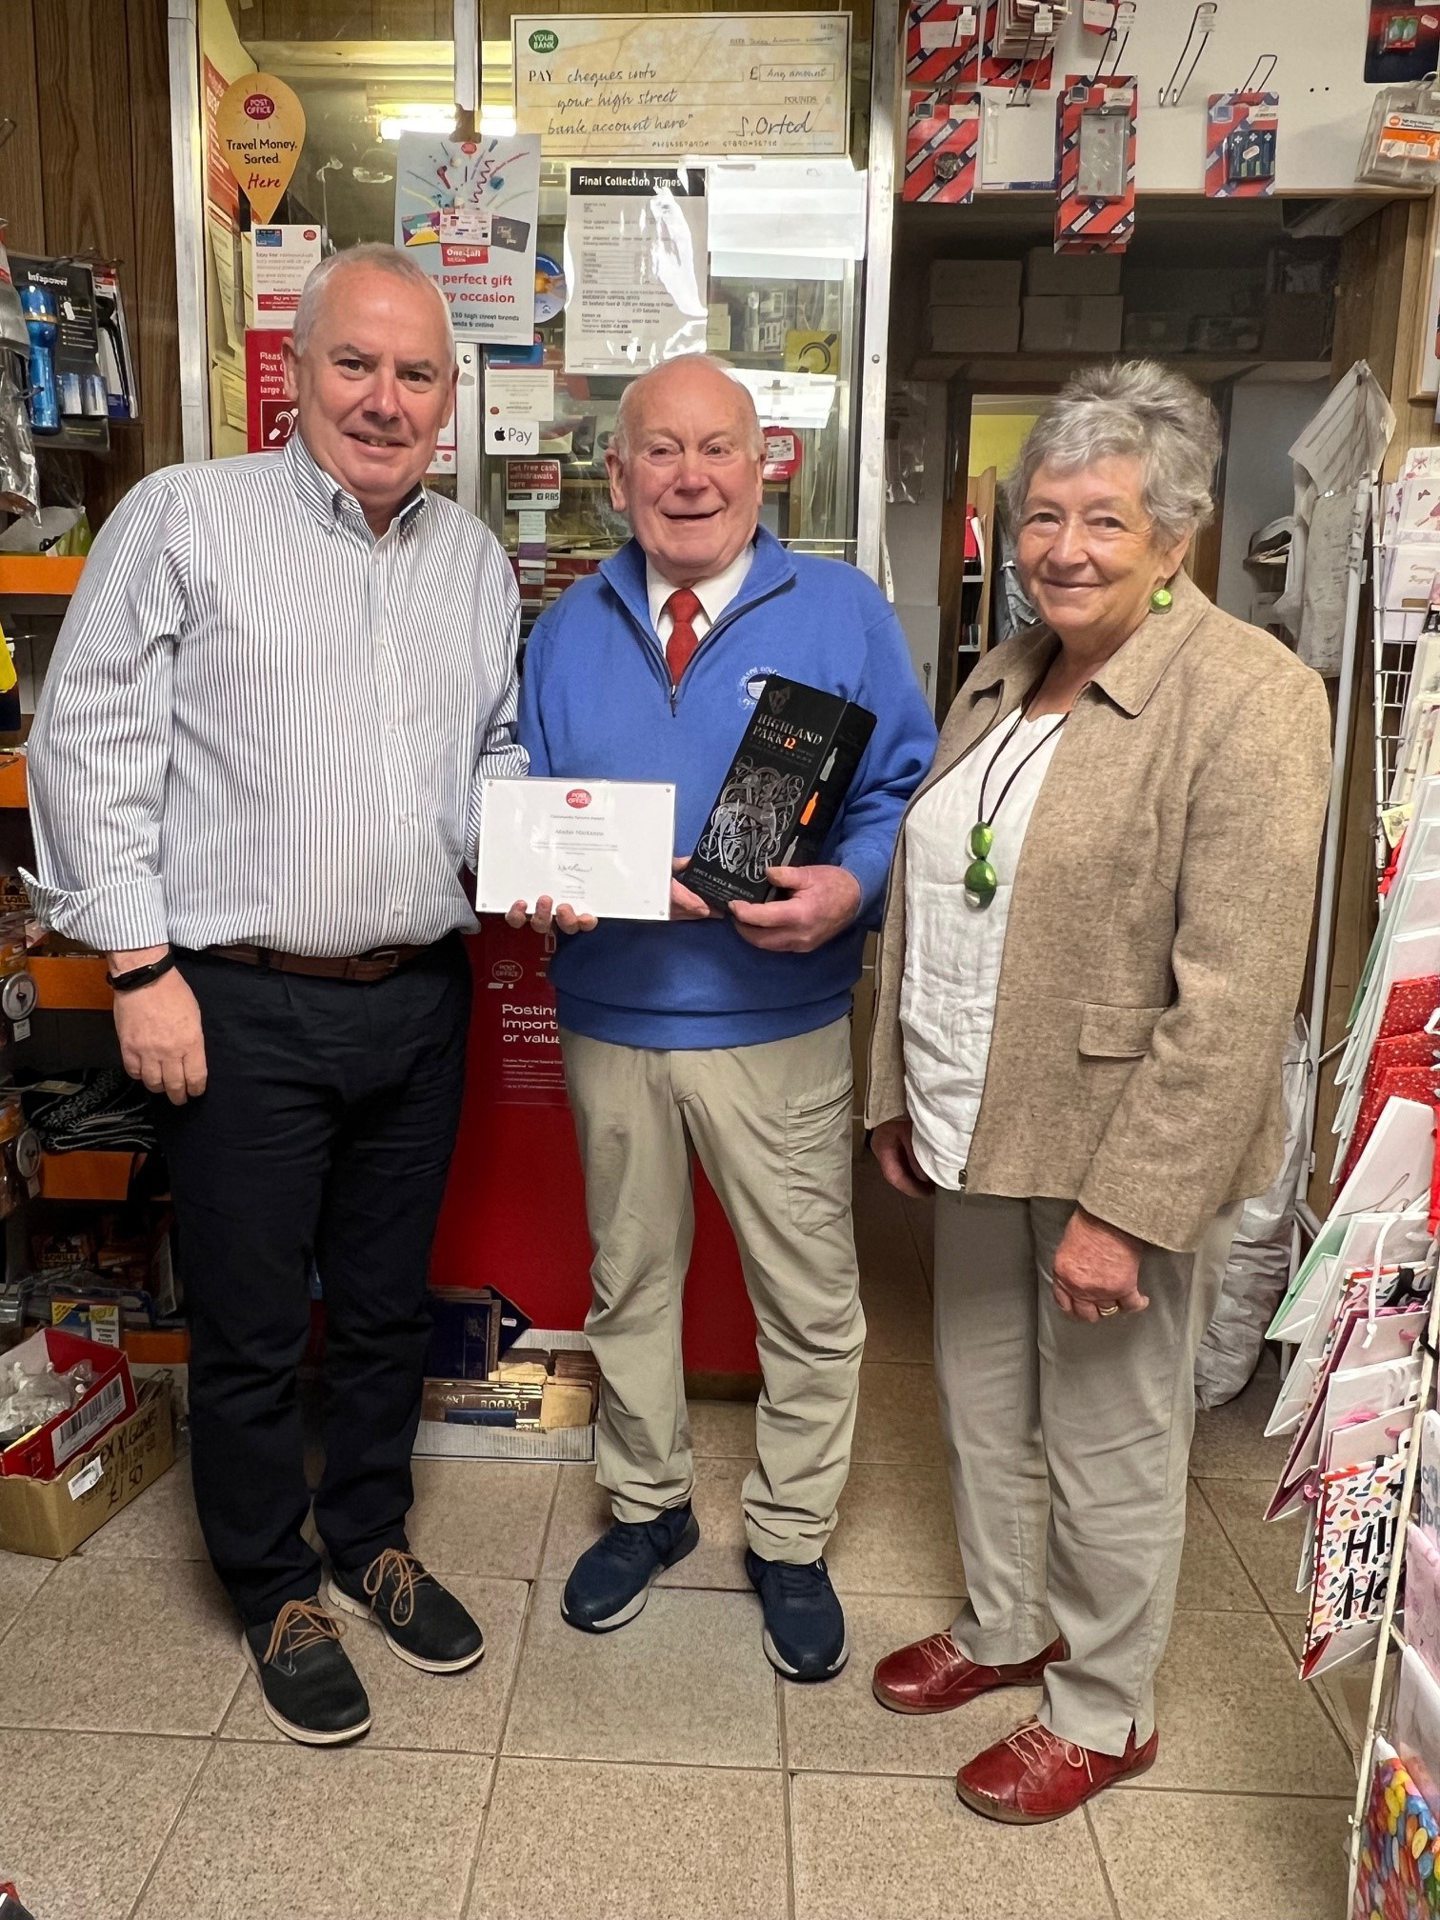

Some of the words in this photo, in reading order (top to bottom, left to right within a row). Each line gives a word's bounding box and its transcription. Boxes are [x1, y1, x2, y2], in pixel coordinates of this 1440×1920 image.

[533, 34, 554, 42] YOUR
[533, 41, 554, 49] BANK
[528, 70, 553, 82] PAY
[567, 69, 623, 87] cheques
[250, 98, 268, 107] POST
[557, 97, 593, 115] your
[597, 91, 633, 115] high
[637, 88, 677, 104] street
[246, 106, 272, 114] OFFICE
[548, 118, 587, 136] bank
[591, 119, 650, 133] account
[226, 138, 257, 151] Travel
[259, 139, 298, 152] Money.
[247, 172, 282, 190] Here
[579, 175, 602, 186] Final
[605, 175, 651, 187] Collection
[653, 176, 681, 188] Times
[442, 273, 488, 286] perfect
[491, 274, 513, 288] gift
[459, 291, 516, 304] occasion
[260, 351, 282, 361] Pleas
[260, 386, 280, 395] large
[508, 427, 533, 446] Pay
[540, 463, 558, 472] cash
[752, 725, 782, 745] PARK
[757, 712, 823, 746] HIGHLAND
[503, 1034, 519, 1043] or
